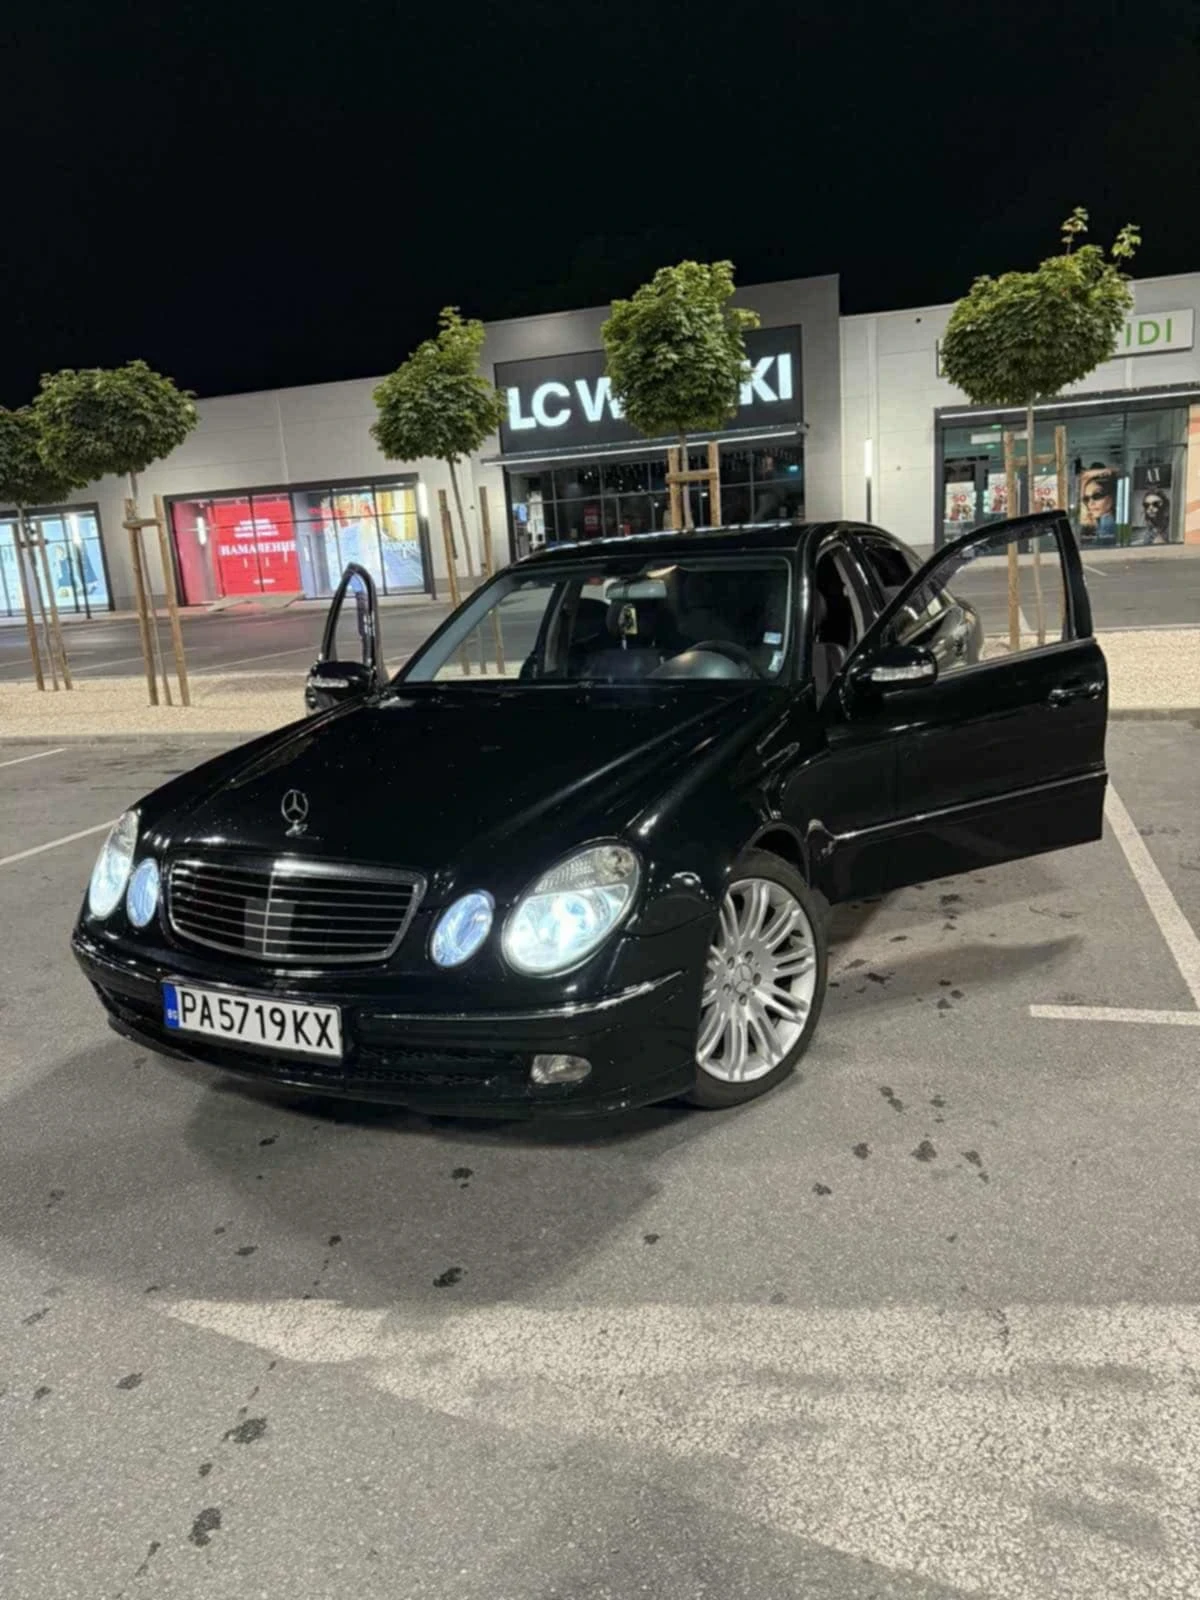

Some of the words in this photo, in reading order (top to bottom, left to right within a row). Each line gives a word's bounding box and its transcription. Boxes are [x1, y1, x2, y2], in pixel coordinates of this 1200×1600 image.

[1125, 318, 1173, 347] IDI
[507, 381, 571, 430] LC
[180, 991, 334, 1049] PA5719KX
